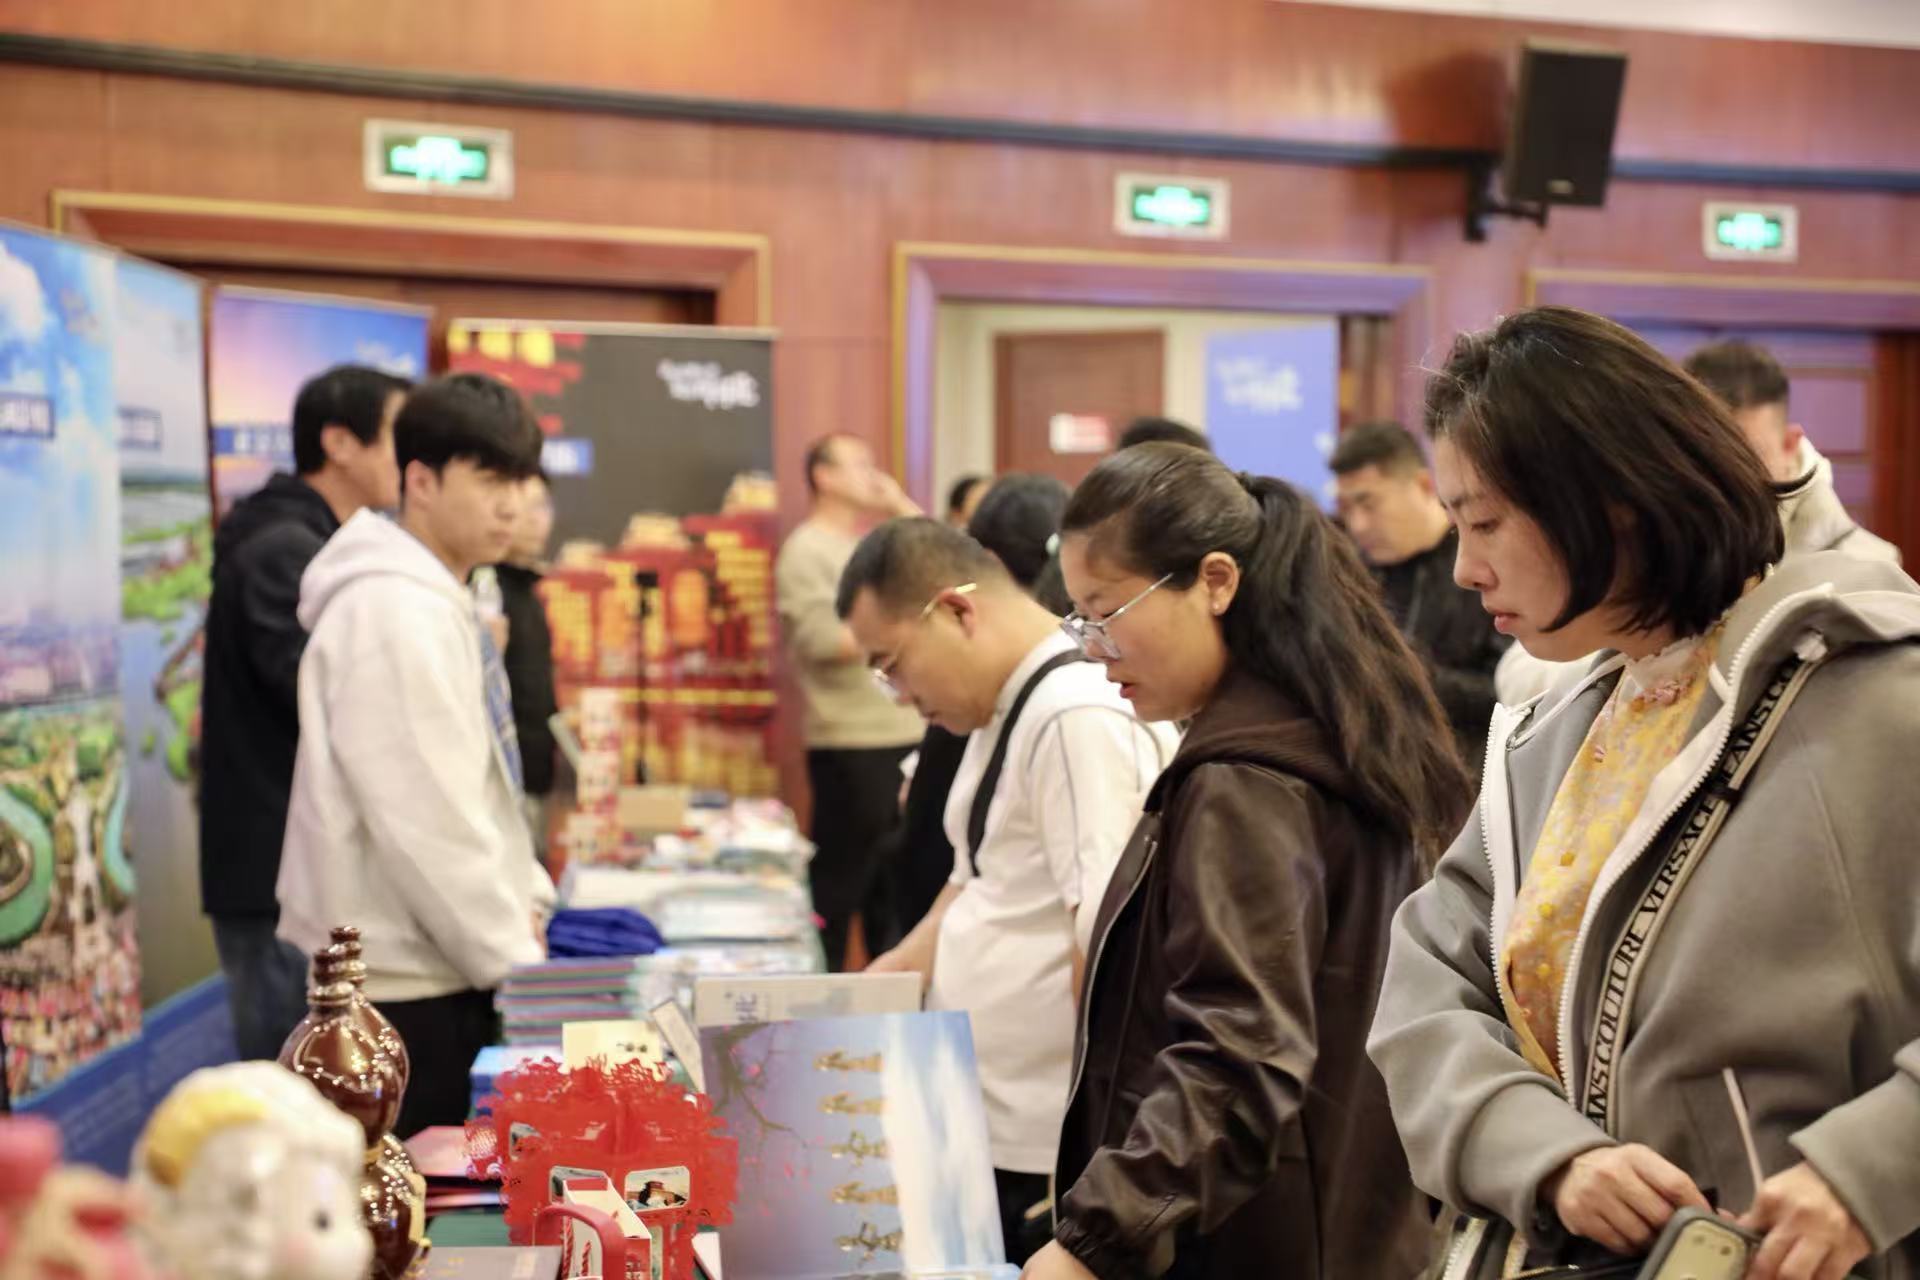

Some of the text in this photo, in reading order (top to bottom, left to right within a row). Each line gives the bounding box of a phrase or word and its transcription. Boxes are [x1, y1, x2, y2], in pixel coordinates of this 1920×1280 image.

[1596, 926, 1647, 1065] COUTURE
[1639, 796, 1719, 915] VERSACE
[1713, 704, 1773, 786] EANS
